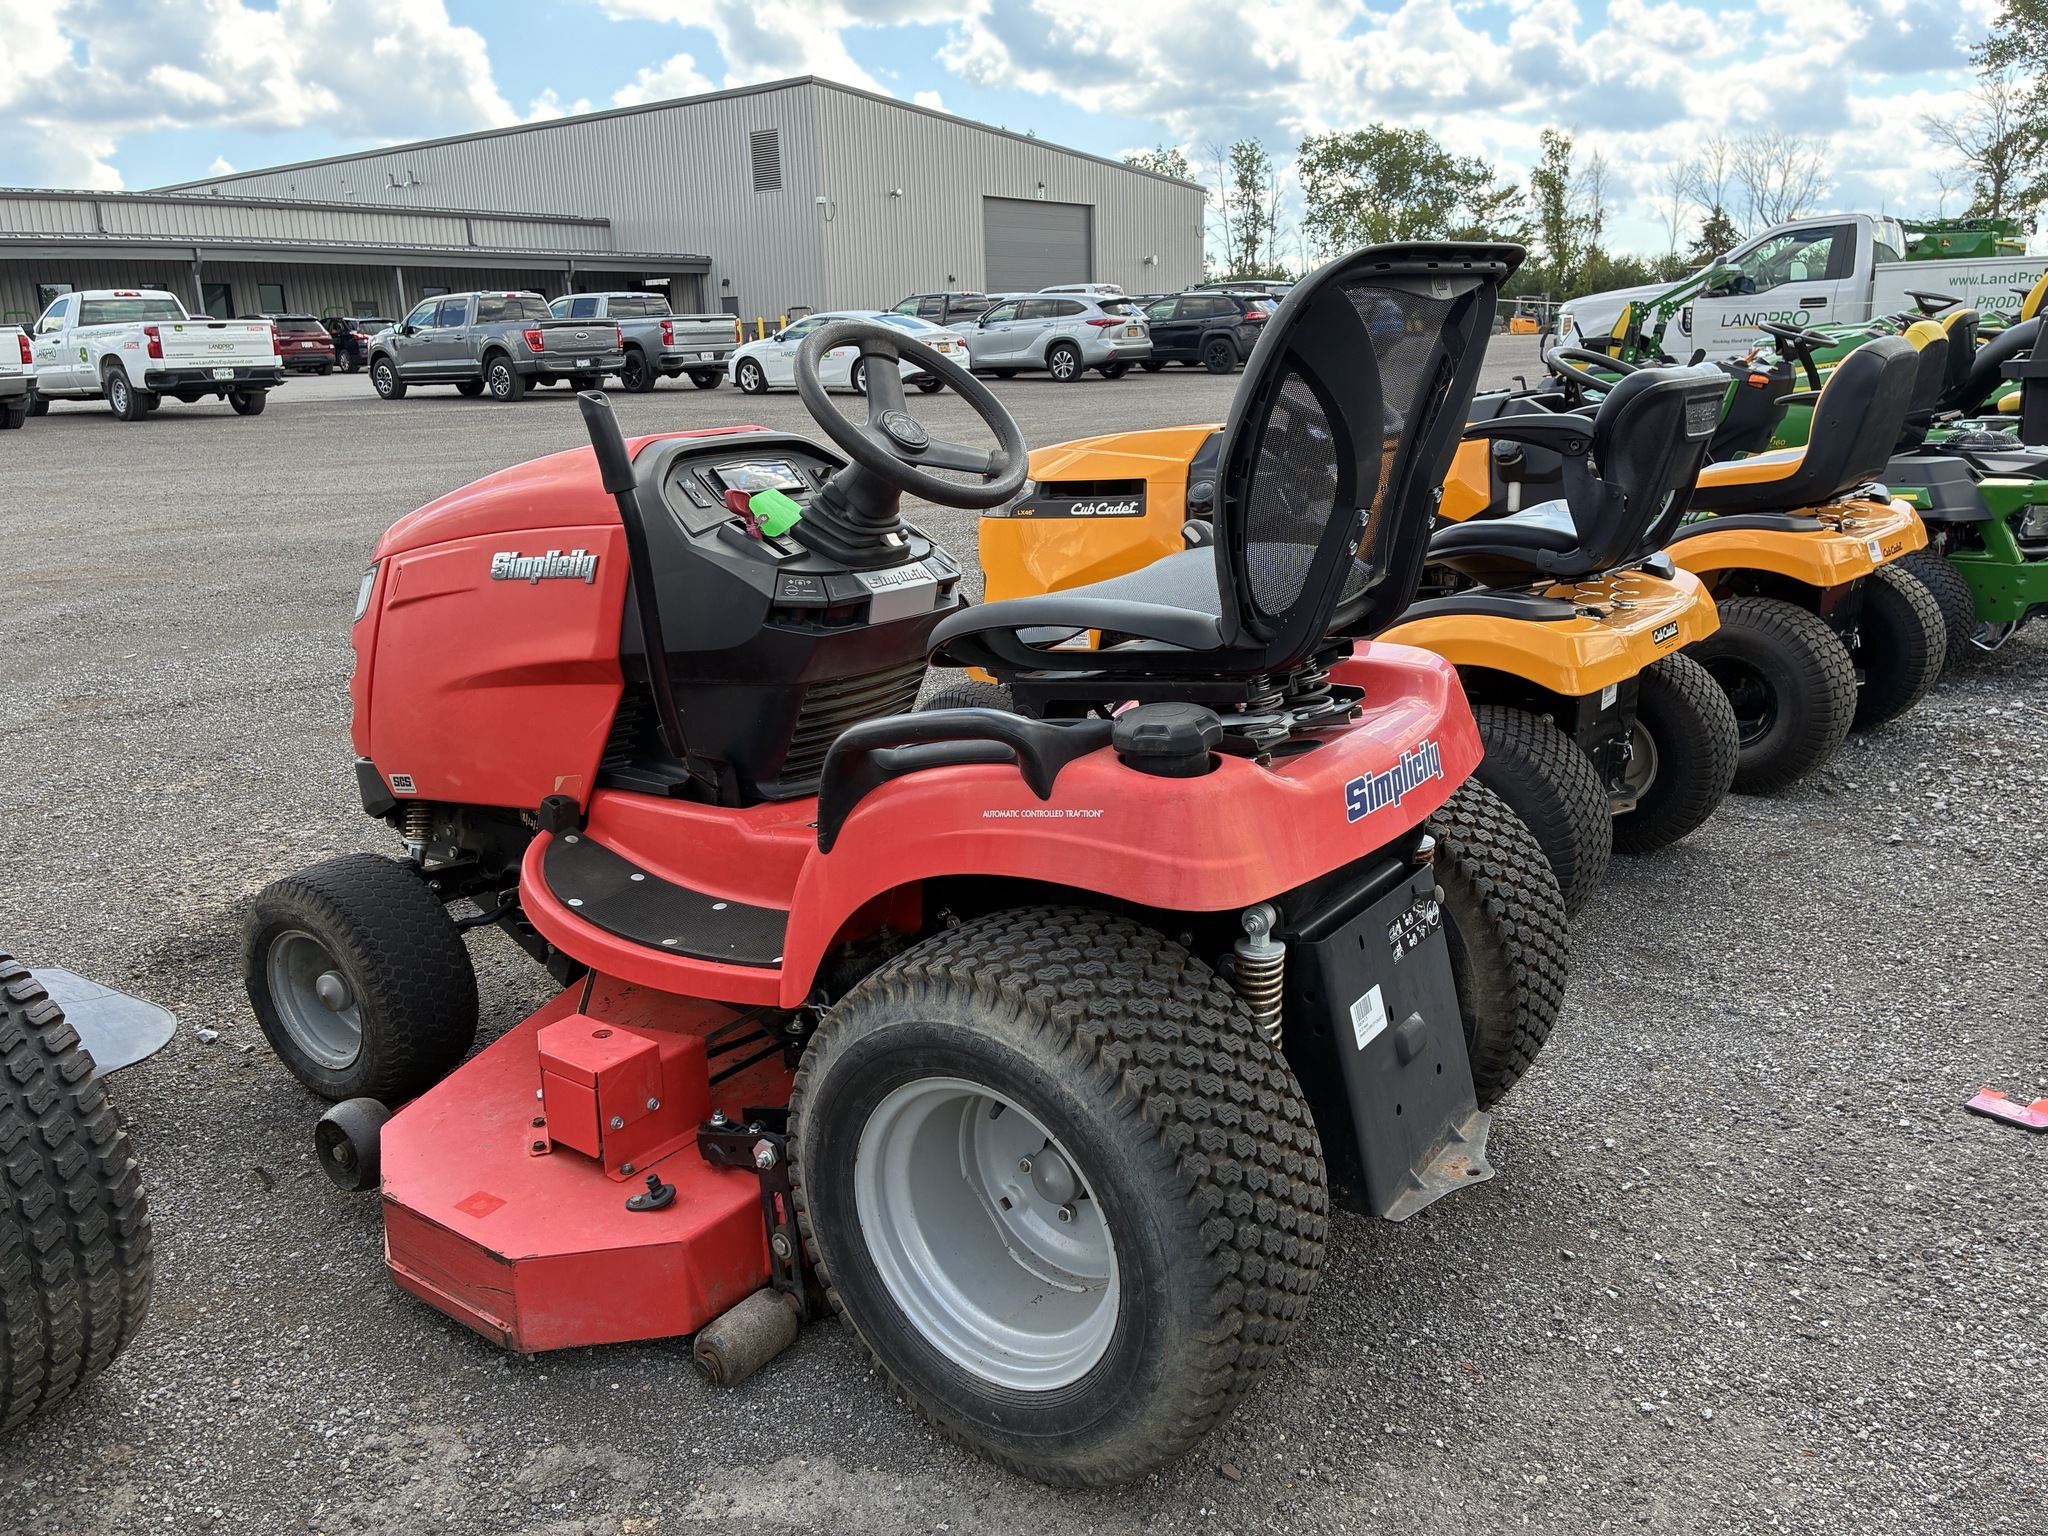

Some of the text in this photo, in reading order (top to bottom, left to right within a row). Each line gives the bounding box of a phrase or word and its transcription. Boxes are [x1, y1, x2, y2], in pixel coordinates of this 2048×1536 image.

[1948, 272, 2044, 286] www.LandPro
[1720, 310, 1811, 327] LANDPRO
[208, 343, 235, 351] LANDPRO
[1070, 501, 1139, 515] Cub Cadet
[490, 549, 600, 585] Simplicity
[866, 568, 932, 589] Simplicity
[392, 776, 412, 787] SCS
[1344, 739, 1445, 824] Simplicity
[982, 809, 1020, 818] AUTOMATIC
[1020, 809, 1064, 818] CONTROLLED
